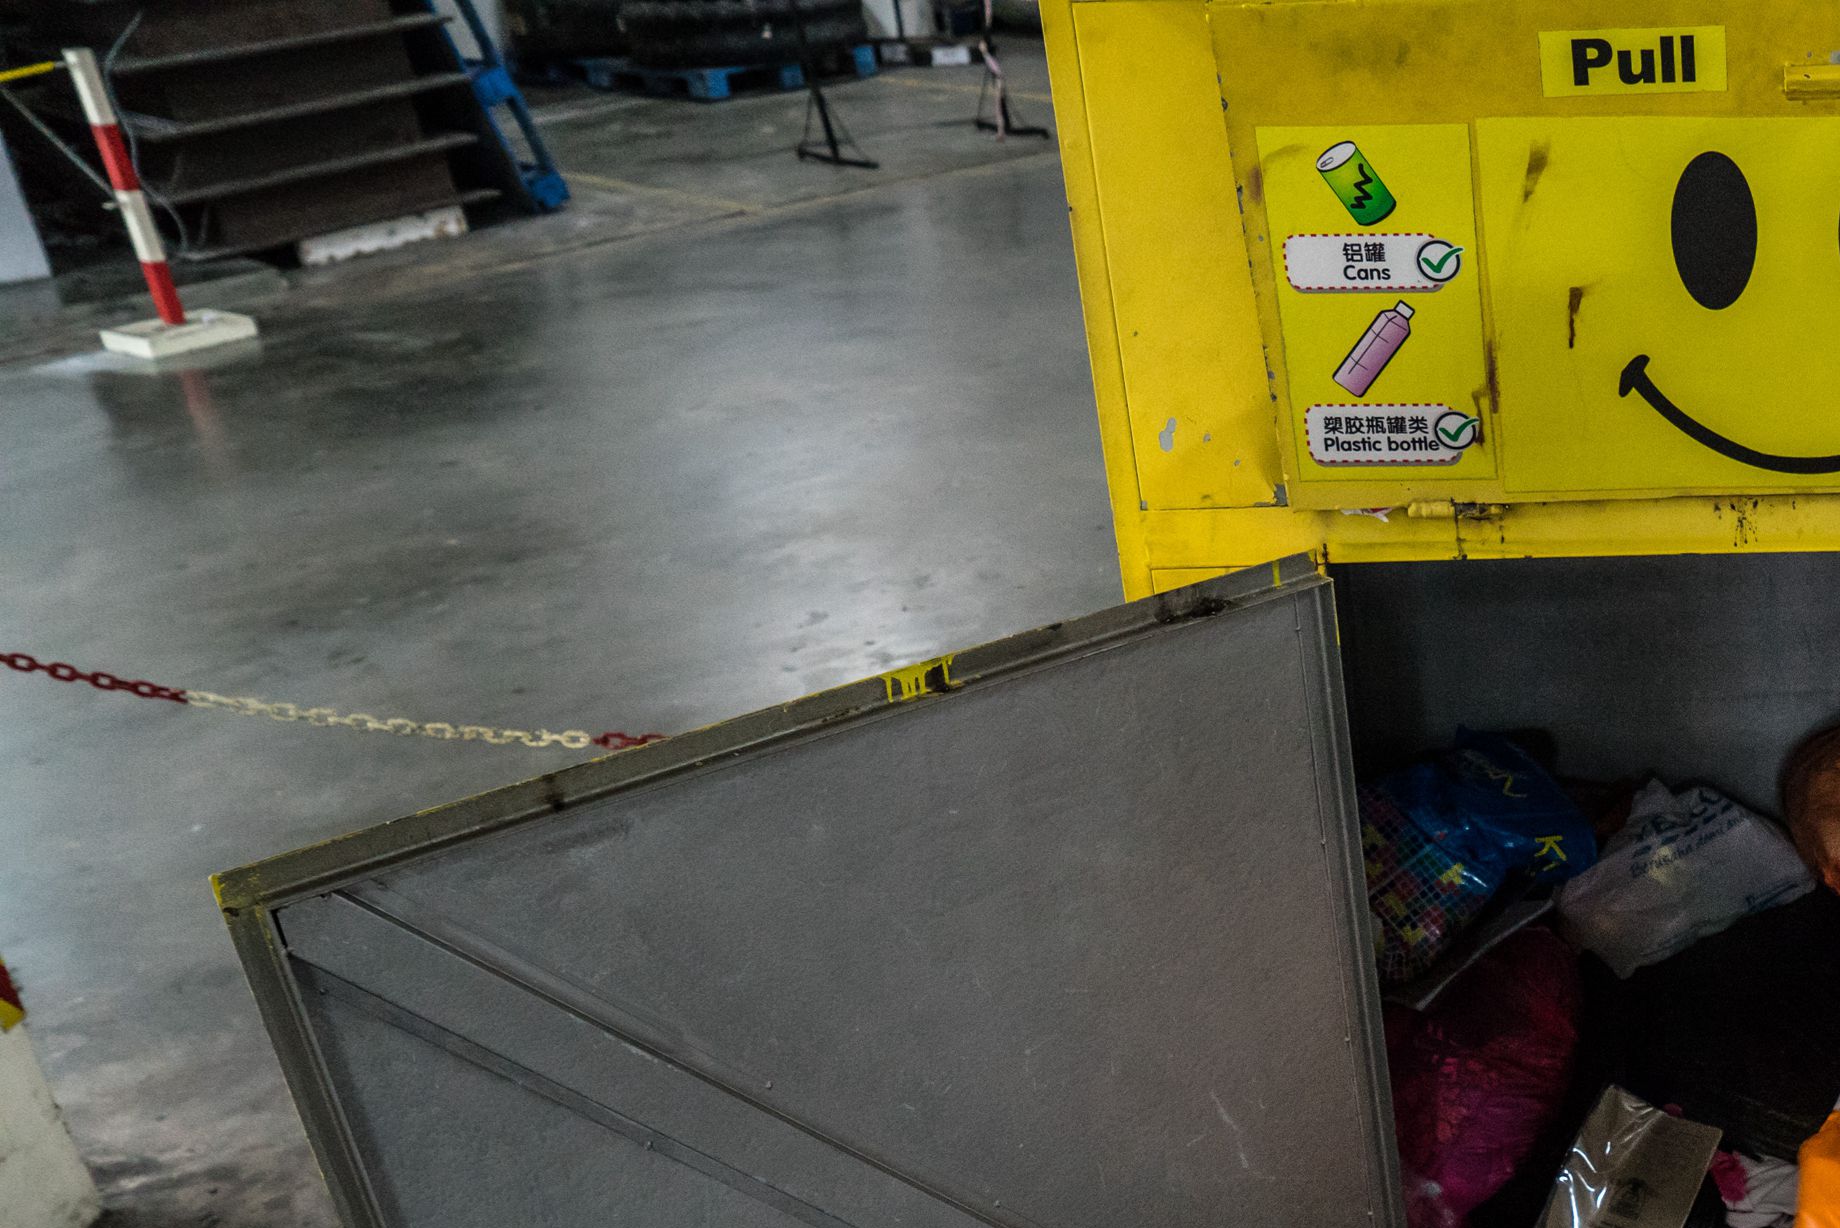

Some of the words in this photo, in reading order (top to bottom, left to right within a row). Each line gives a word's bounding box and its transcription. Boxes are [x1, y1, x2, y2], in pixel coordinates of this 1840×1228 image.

[1570, 34, 1697, 86] Pull
[1342, 242, 1386, 263] 铝罐
[1343, 264, 1391, 281] Cans
[1323, 436, 1382, 452] Plastic
[1387, 436, 1440, 452] bottle
